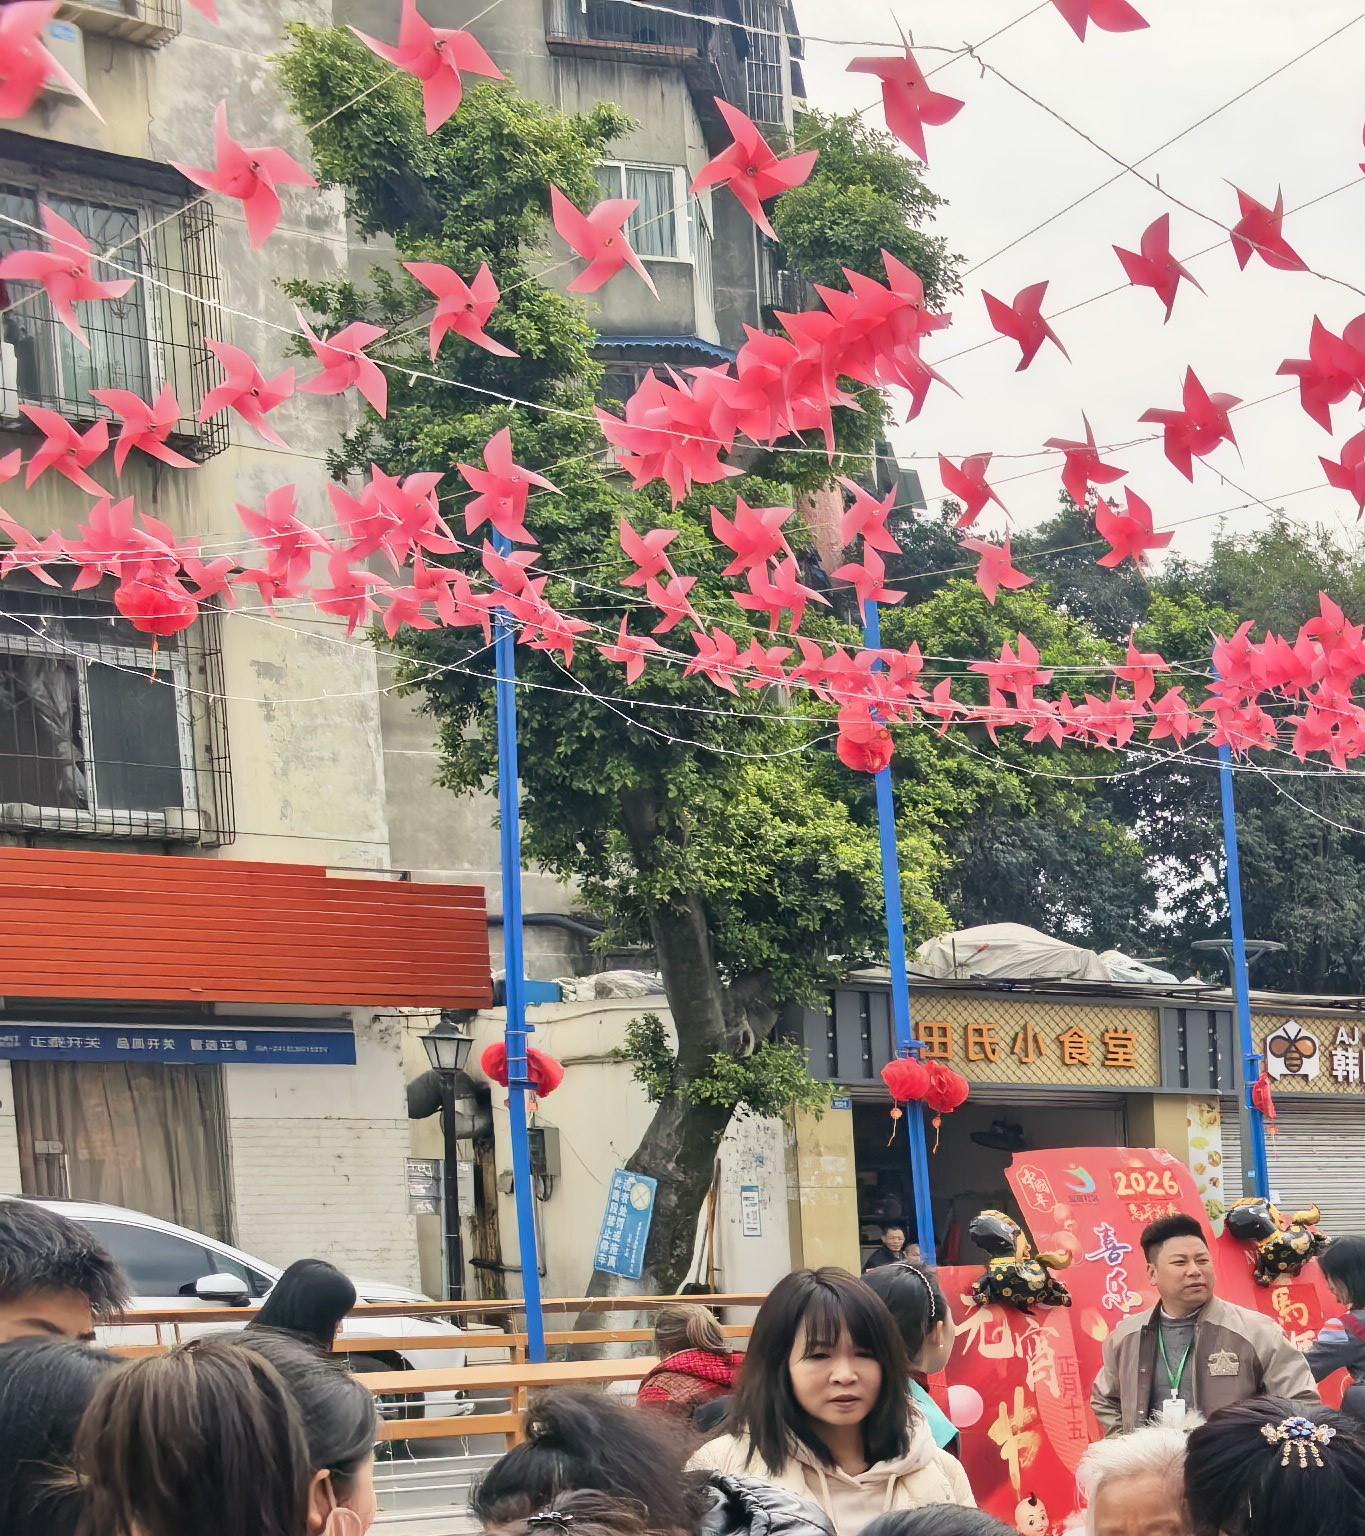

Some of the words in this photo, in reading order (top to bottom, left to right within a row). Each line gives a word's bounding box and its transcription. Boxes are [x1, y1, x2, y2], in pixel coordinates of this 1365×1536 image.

[917, 1021, 1138, 1068] 田氏小食堂
[1335, 1026, 1359, 1046] AJ
[1113, 1170, 1179, 1196] 2026
[1057, 1355, 1086, 1440] 正月十五
